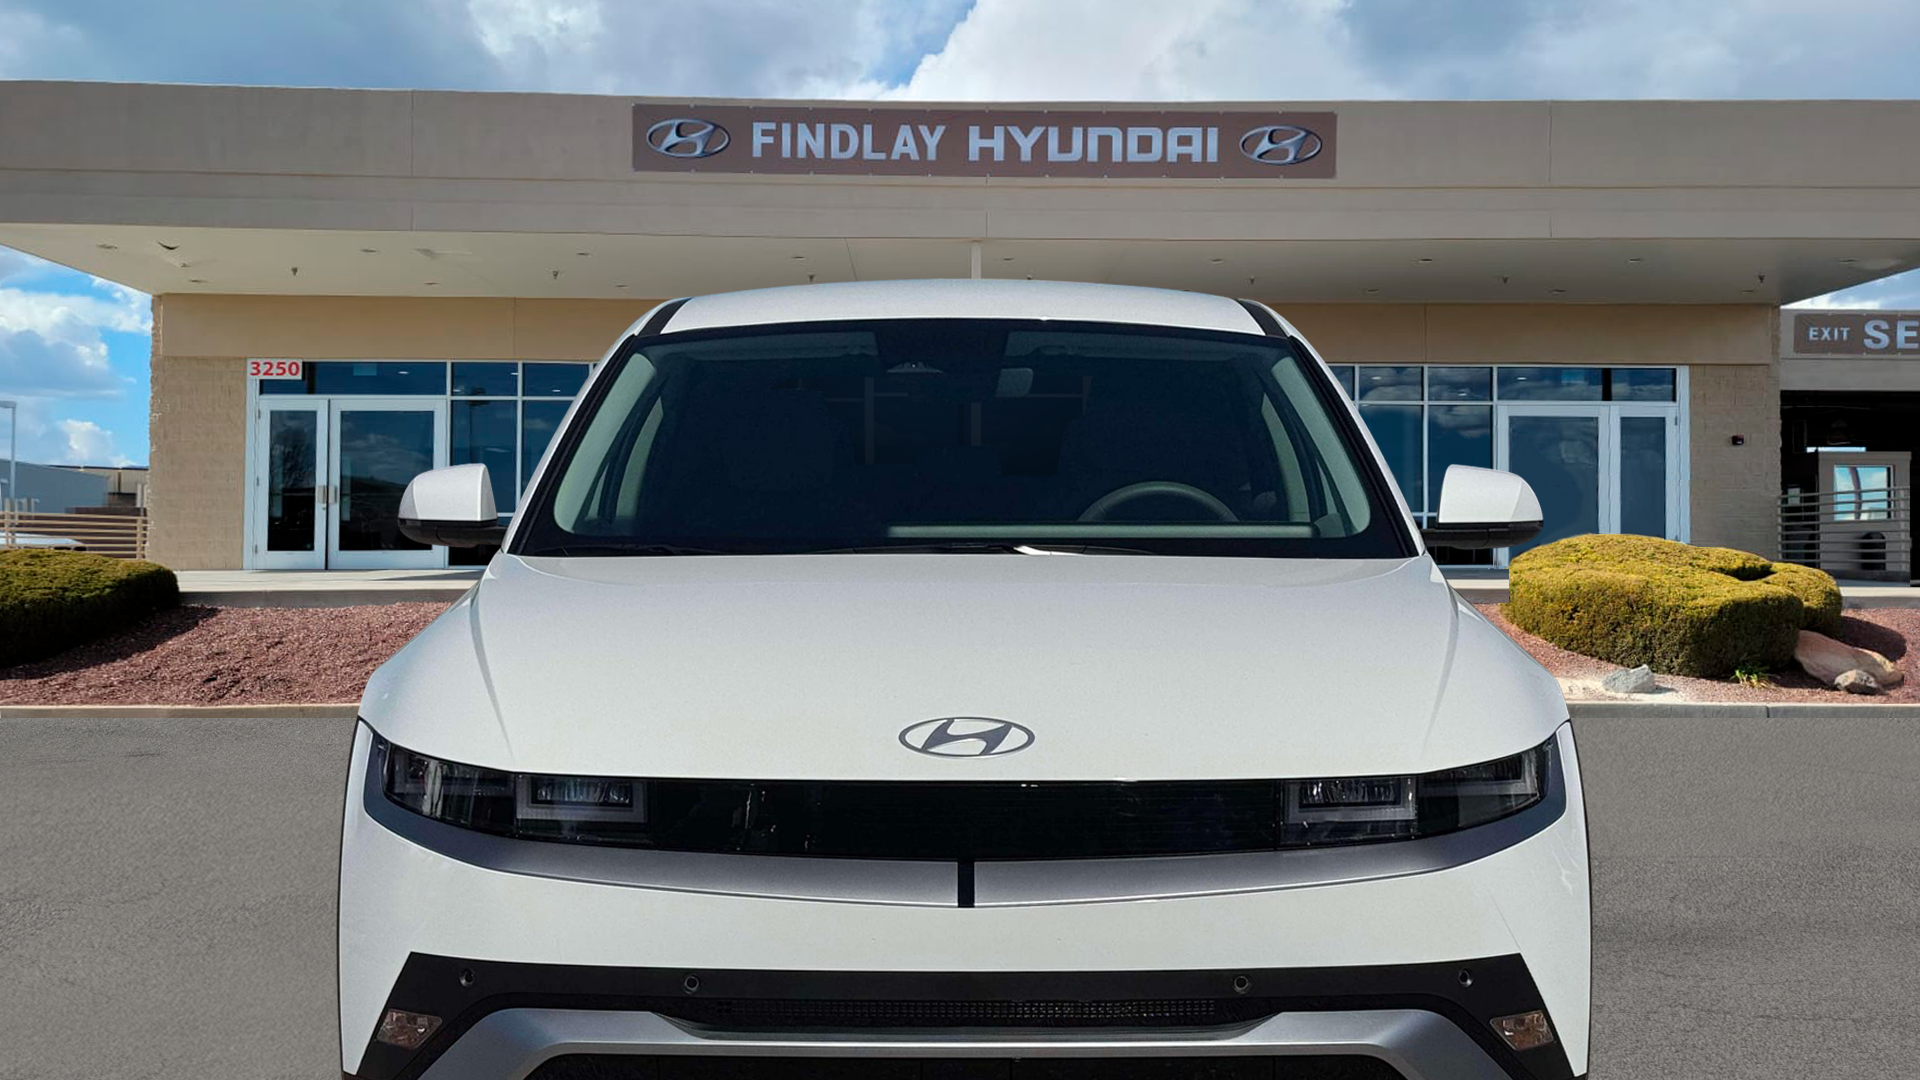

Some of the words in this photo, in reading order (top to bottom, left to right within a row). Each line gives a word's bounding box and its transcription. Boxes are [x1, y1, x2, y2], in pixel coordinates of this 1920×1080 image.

[752, 122, 946, 161] FINDLAY
[968, 125, 1218, 163] HYUNDAI
[1808, 326, 1850, 341] EXIT
[250, 361, 300, 376] 3250
